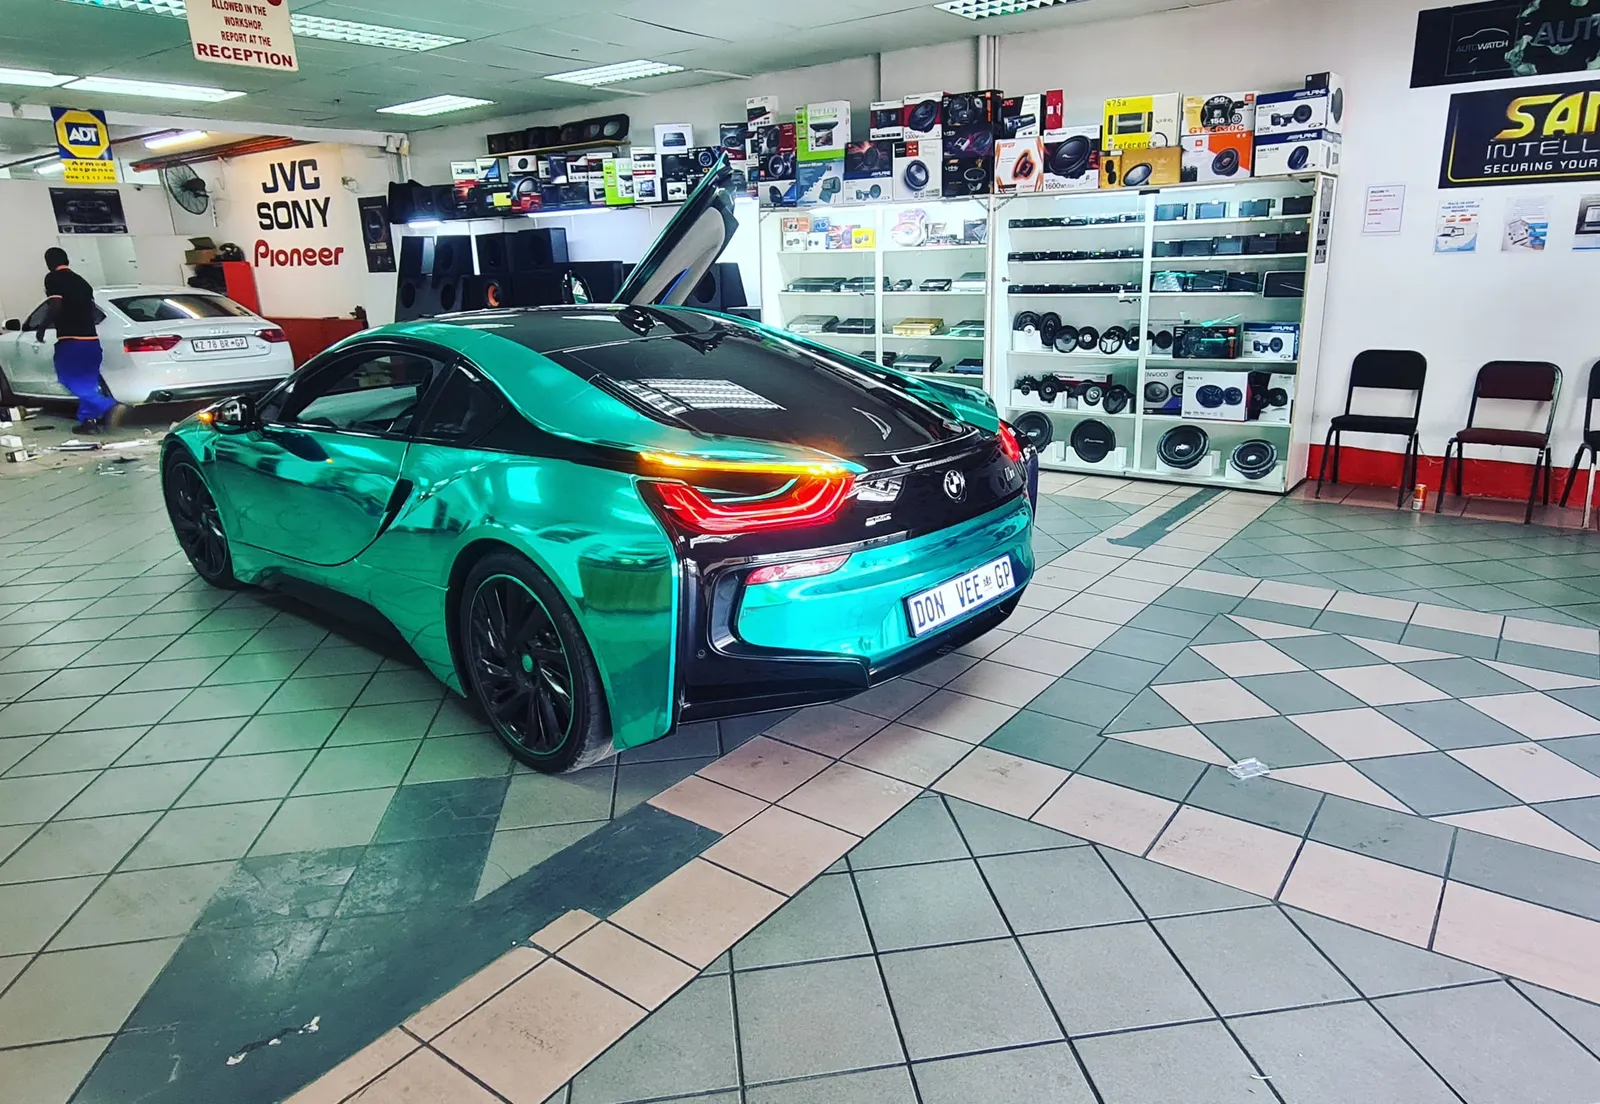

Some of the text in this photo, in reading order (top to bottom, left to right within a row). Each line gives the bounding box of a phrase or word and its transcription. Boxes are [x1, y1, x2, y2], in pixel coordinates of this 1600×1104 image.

[211, 0, 267, 17] ALLOWED IN THE
[223, 16, 263, 31] WORKSHOP.
[220, 31, 272, 47] REPORT AT THE
[1456, 40, 1509, 52] AUTOWATCH
[196, 43, 293, 67] RECEPTION
[69, 127, 97, 143] ADT
[1483, 158, 1598, 175] SECURING YOUR
[261, 159, 321, 194] JVC
[257, 197, 331, 230] SONY
[254, 239, 344, 267] Pioneer
[208, 340, 218, 348] 78
[235, 339, 245, 347] GP
[913, 561, 1010, 628] DON VEE GP
